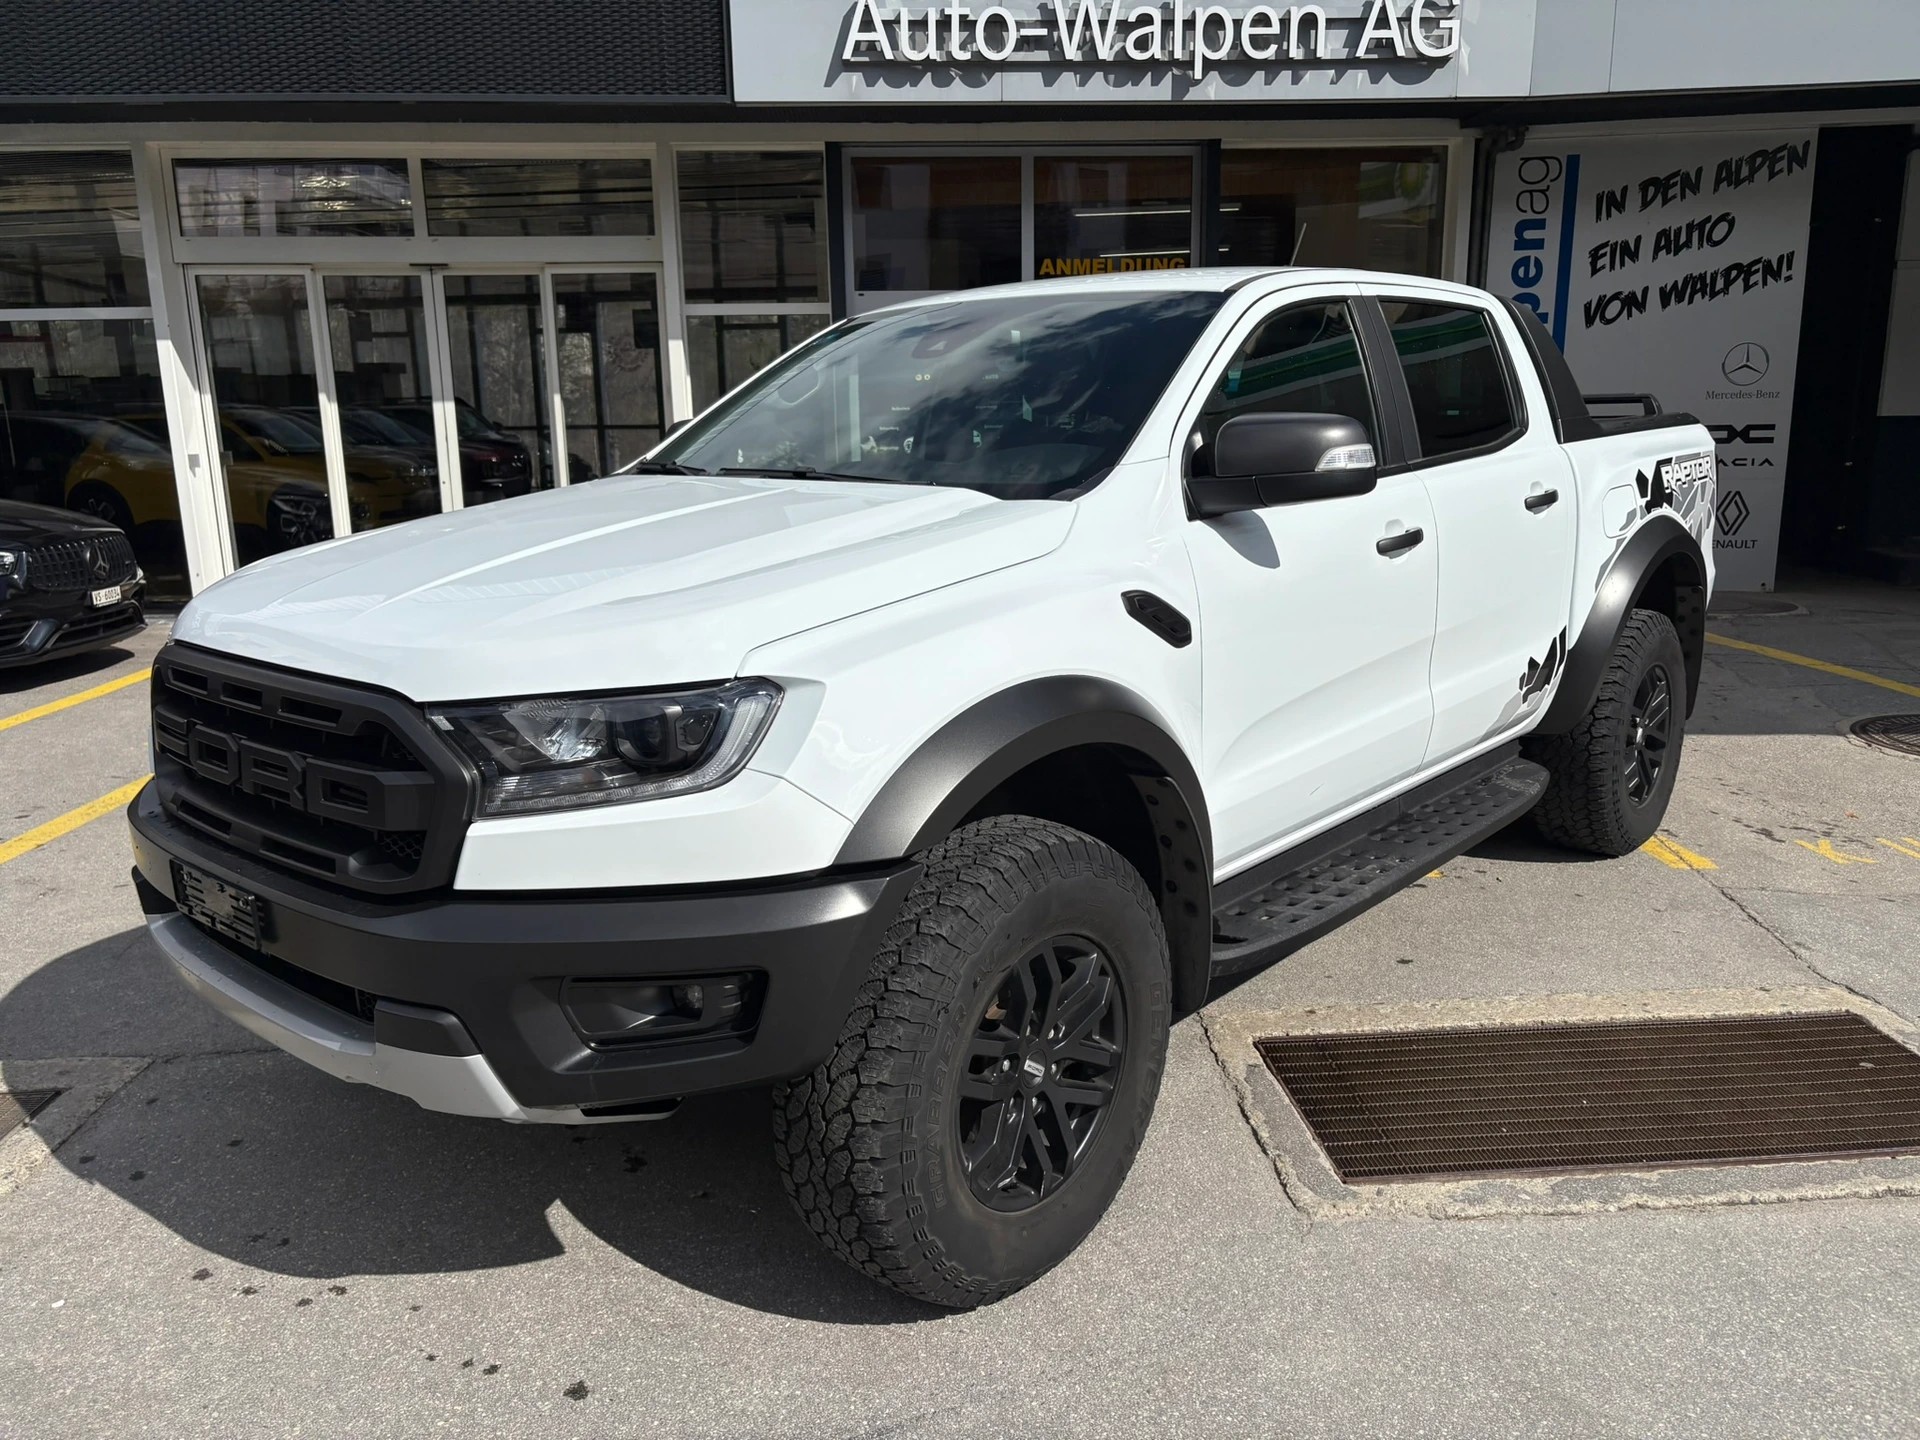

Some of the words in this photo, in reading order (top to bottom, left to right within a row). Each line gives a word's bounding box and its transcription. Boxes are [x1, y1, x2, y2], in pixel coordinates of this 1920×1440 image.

[841, 0, 1327, 80] Auto-Walpen
[1355, 0, 1461, 58] AG
[1595, 184, 1629, 224] IN
[1638, 165, 1704, 213] DEN
[1712, 139, 1811, 196] ALPEN
[1039, 257, 1186, 276] ANMELDUNG
[1588, 234, 1643, 279] EIN
[1651, 211, 1736, 263] AUTO
[1583, 285, 1650, 330] VON
[1658, 249, 1796, 312] WALPEN!
[1705, 389, 1781, 400] Mercedes-Benz
[1660, 456, 1715, 496] RAPTOR
[1716, 457, 1775, 467] ACIA
[153, 704, 392, 830] FORD
